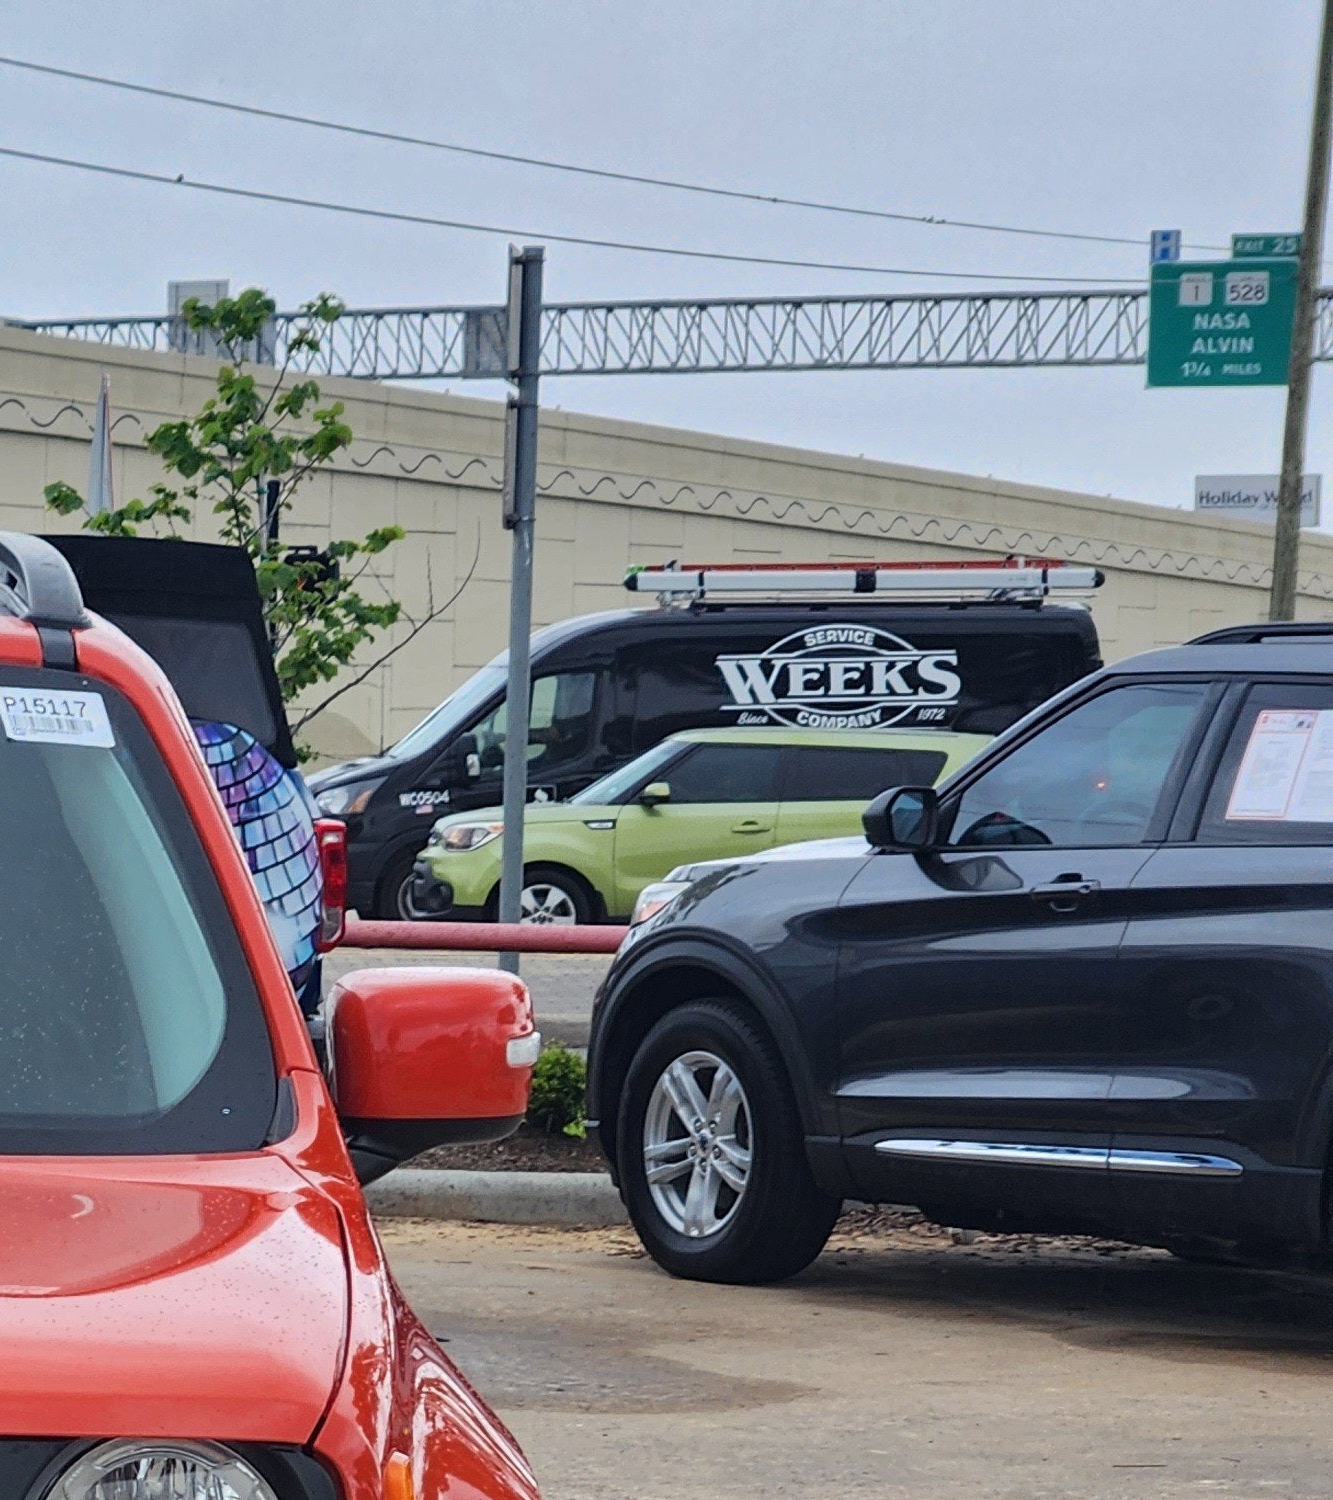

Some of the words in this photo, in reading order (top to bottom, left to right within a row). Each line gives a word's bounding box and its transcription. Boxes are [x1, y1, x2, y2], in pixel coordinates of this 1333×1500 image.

[1192, 284, 1200, 301] 1
[1229, 284, 1266, 302] 528
[1192, 311, 1251, 330] NASA
[1190, 336, 1255, 354] ALVIN
[1222, 362, 1262, 375] MILES
[1198, 488, 1260, 508] Holiday
[803, 628, 876, 648] SERVICE
[714, 654, 962, 704] WEEKS
[3, 696, 87, 718] P15117
[915, 707, 947, 721] 1972
[795, 708, 883, 729] COMPANY
